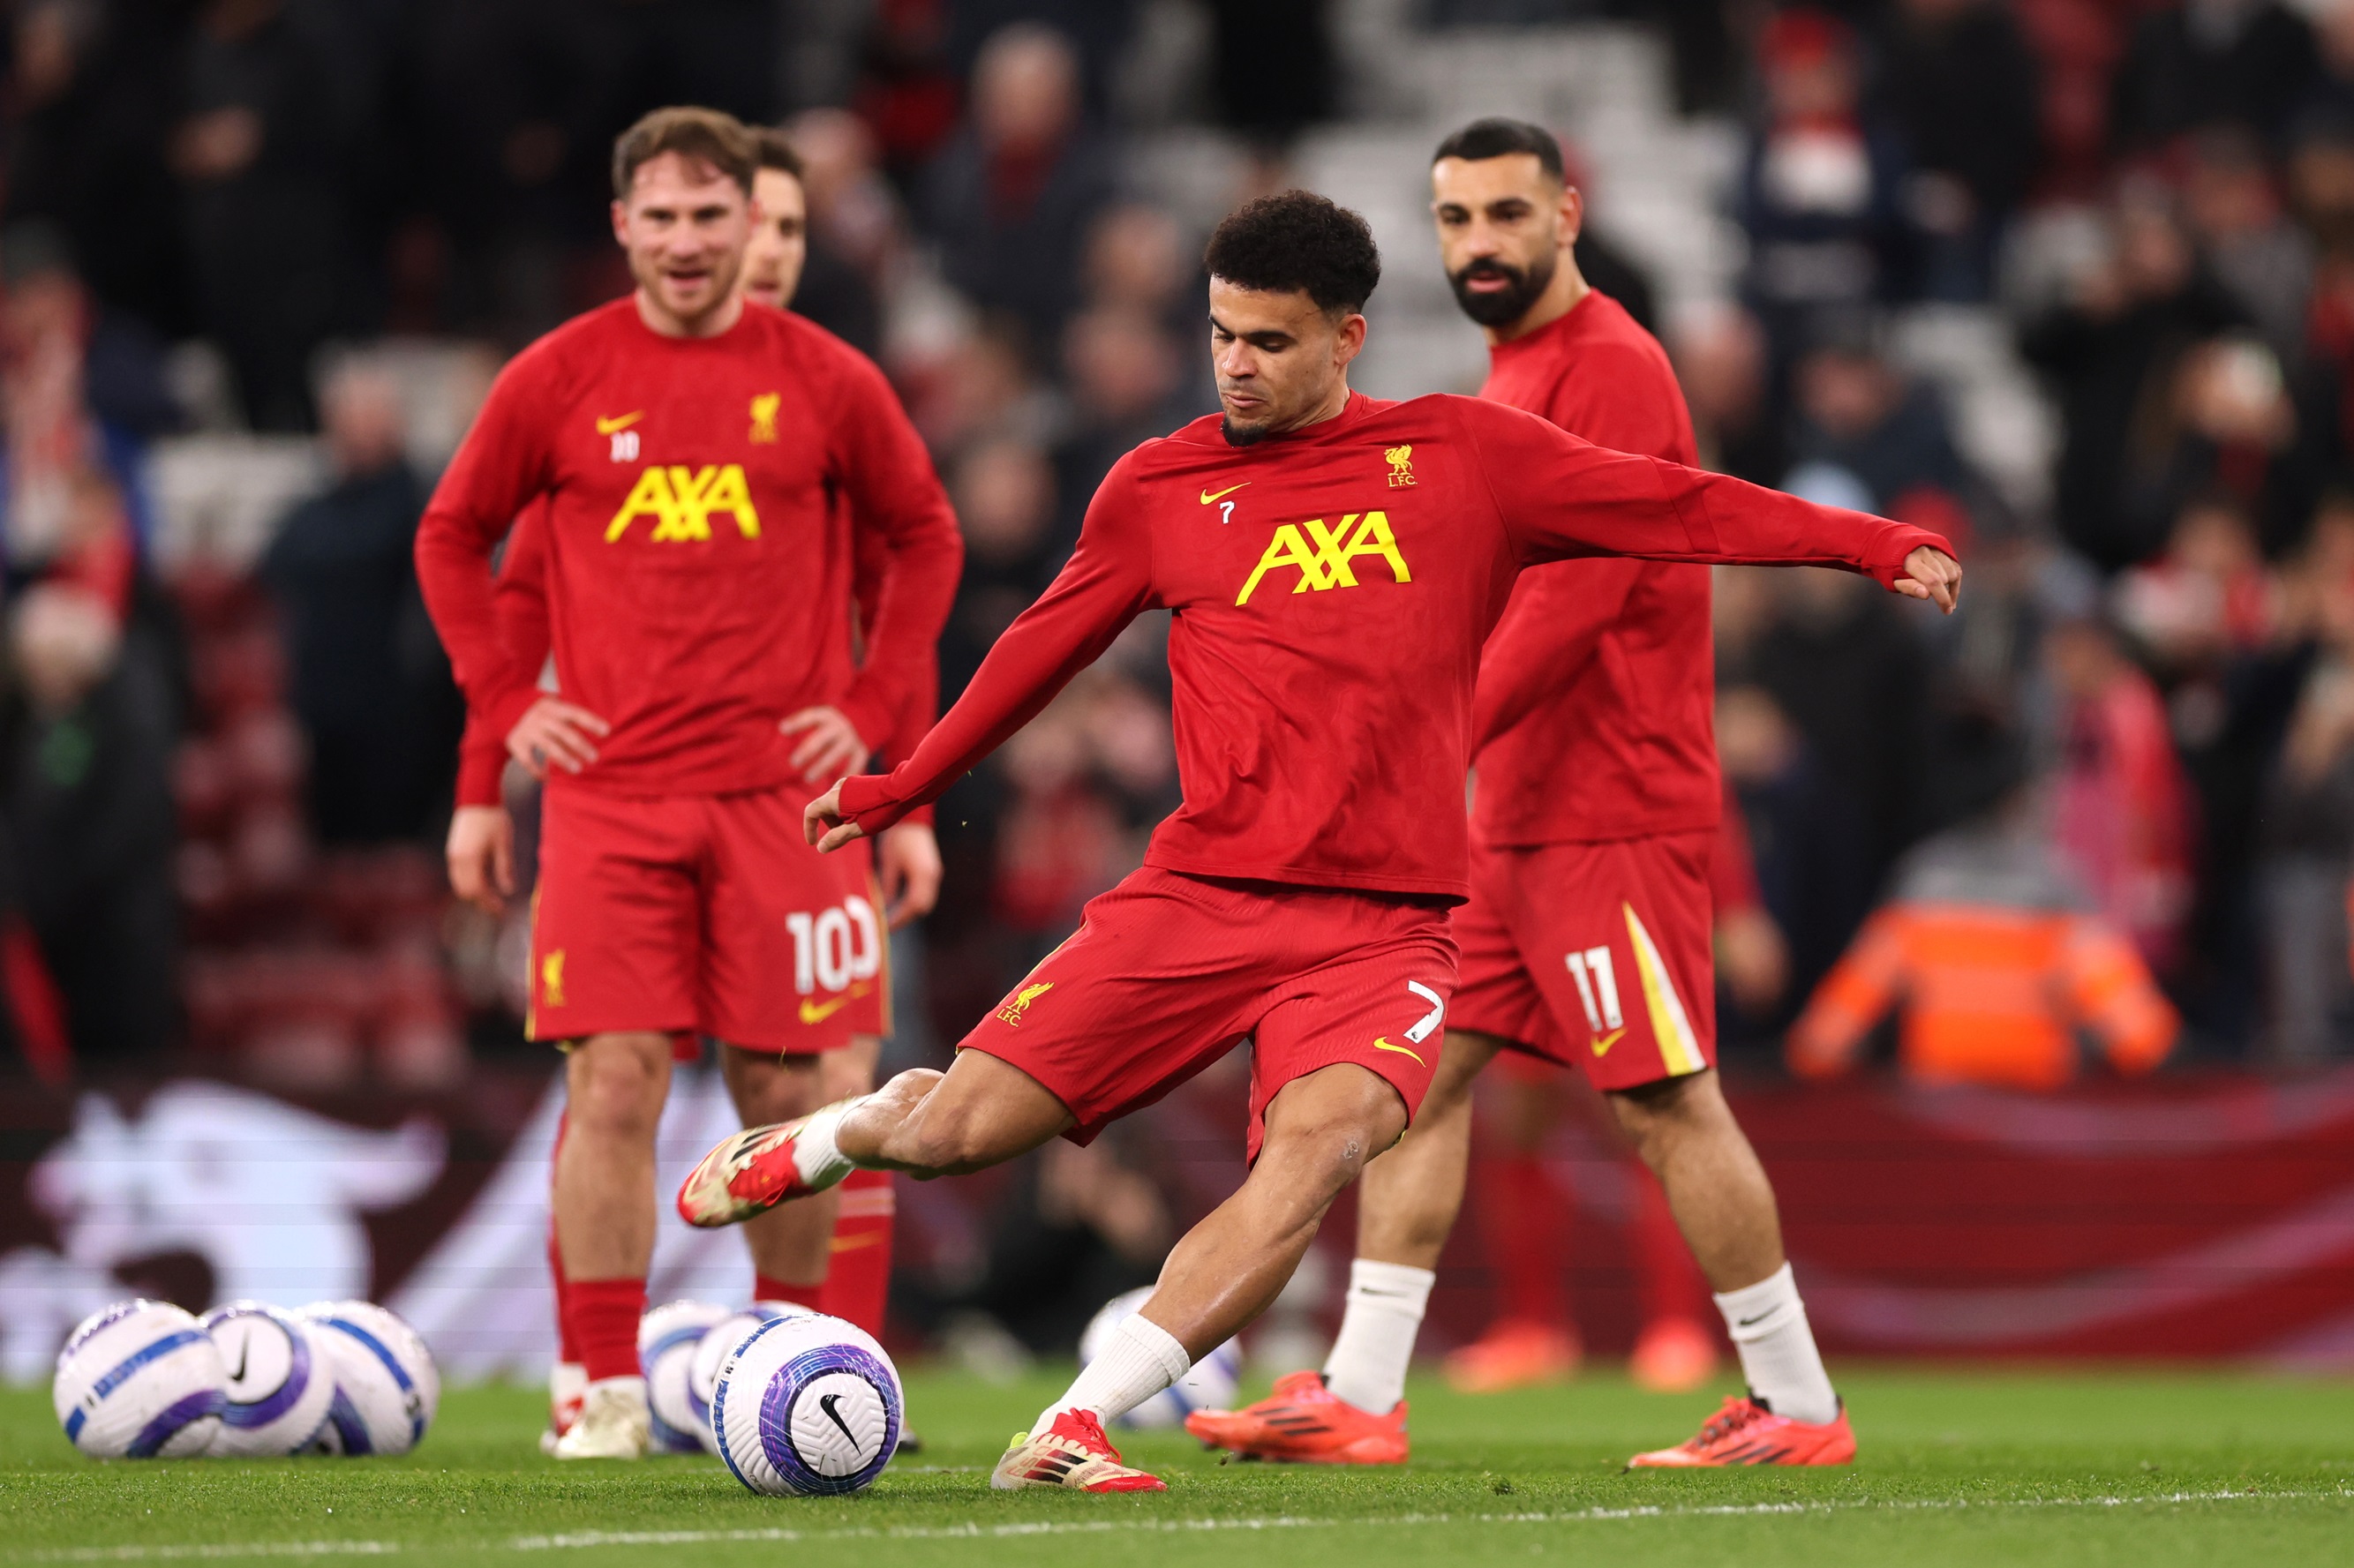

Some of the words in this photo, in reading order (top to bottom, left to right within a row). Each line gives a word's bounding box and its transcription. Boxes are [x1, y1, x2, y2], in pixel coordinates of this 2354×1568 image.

[605, 463, 761, 543] AXA
[1219, 500, 1235, 524] 7
[1235, 511, 1412, 606] AXA
[1403, 979, 1445, 1045] 7
[1565, 945, 1624, 1032] 11
